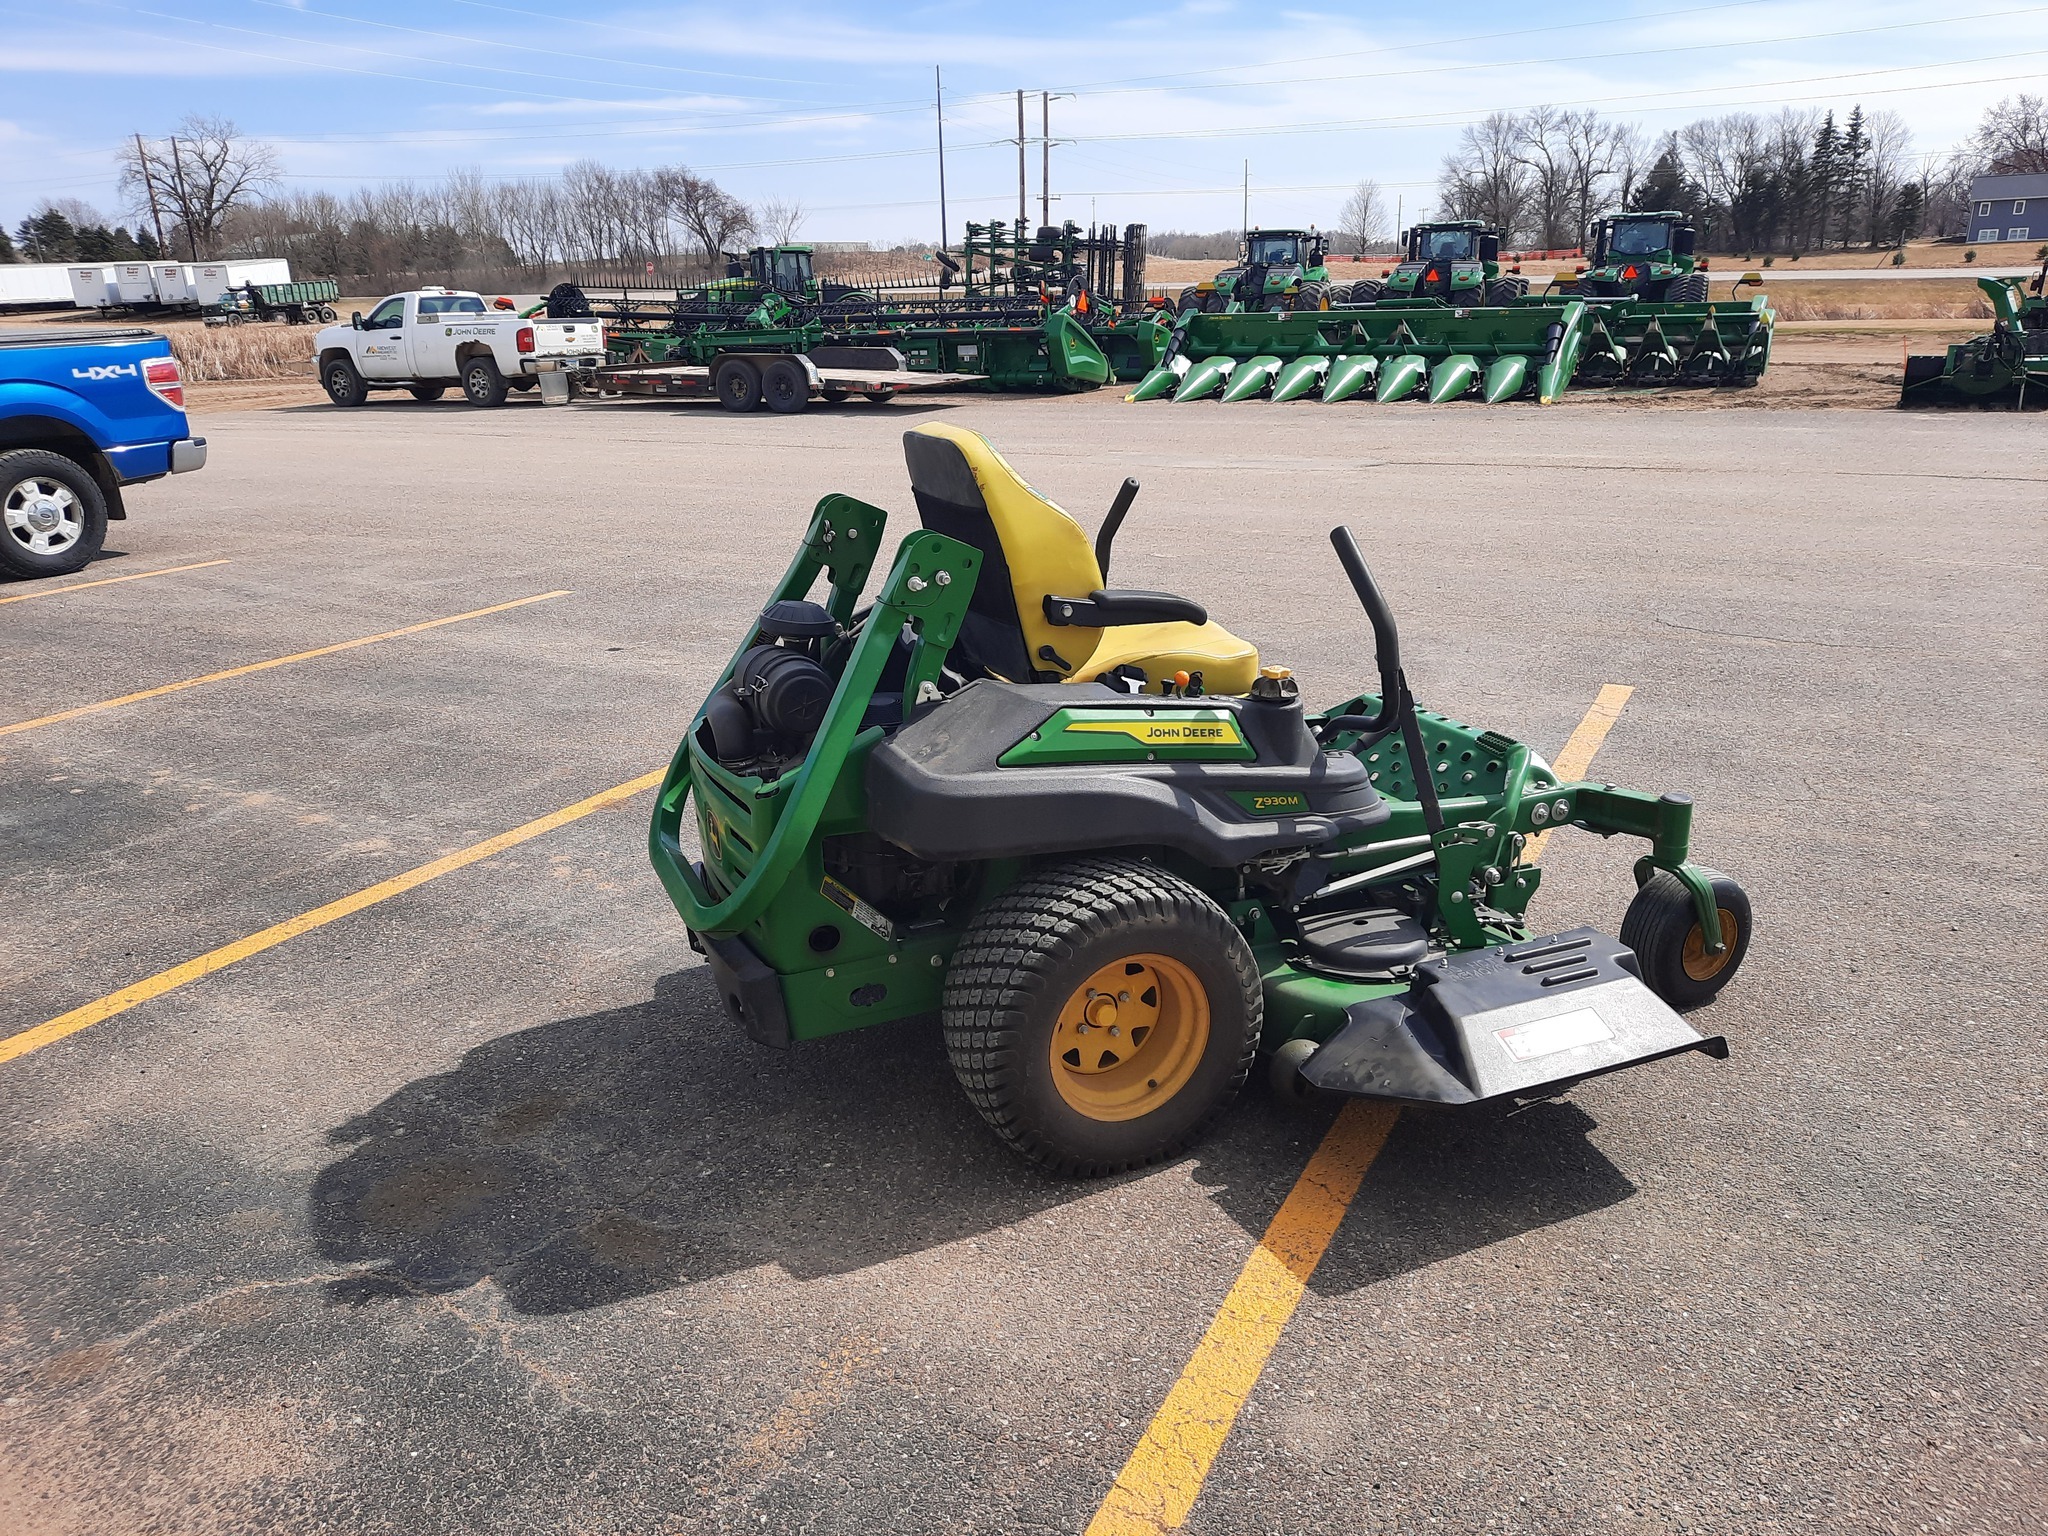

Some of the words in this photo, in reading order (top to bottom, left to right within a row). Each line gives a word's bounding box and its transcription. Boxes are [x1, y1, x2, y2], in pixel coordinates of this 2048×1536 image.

[473, 327, 496, 335] DEERE
[1147, 727, 1180, 738] JOHN
[1183, 727, 1223, 738] DEERE
[1254, 796, 1299, 809] Z930M
